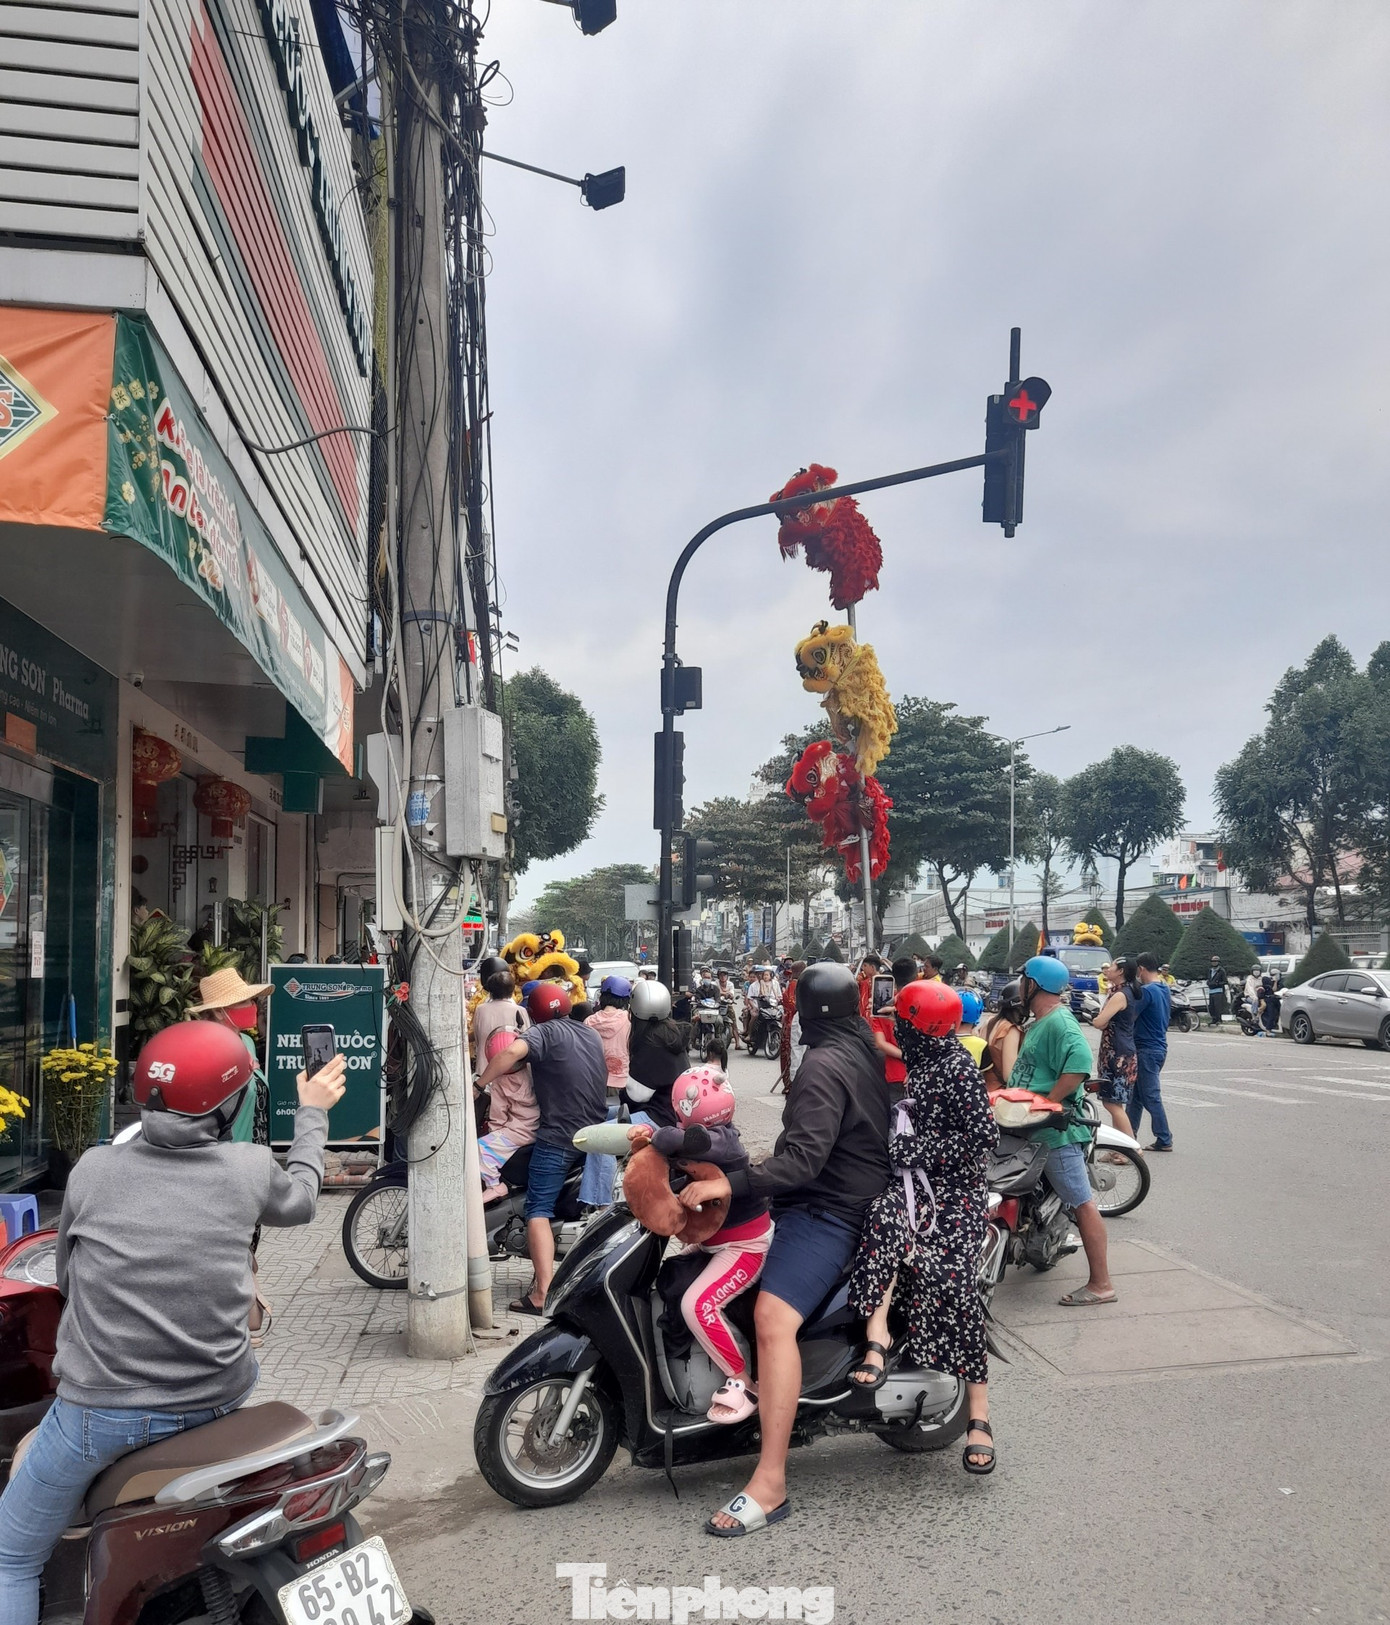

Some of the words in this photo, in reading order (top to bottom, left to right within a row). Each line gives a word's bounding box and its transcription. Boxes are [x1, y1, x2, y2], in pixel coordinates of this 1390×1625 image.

[52, 676, 89, 720] Pharma
[301, 983, 327, 992] TRUNG
[346, 983, 373, 993] Pharma
[277, 1034, 303, 1048] NH
[334, 1029, 376, 1049] UỐC
[147, 1061, 176, 1081] 5G
[276, 1055, 306, 1070] TRU
[276, 1108, 297, 1116] 6h00
[134, 1517, 199, 1542] VISION
[305, 1548, 340, 1570] HONDA
[298, 1552, 379, 1621] 65-B2
